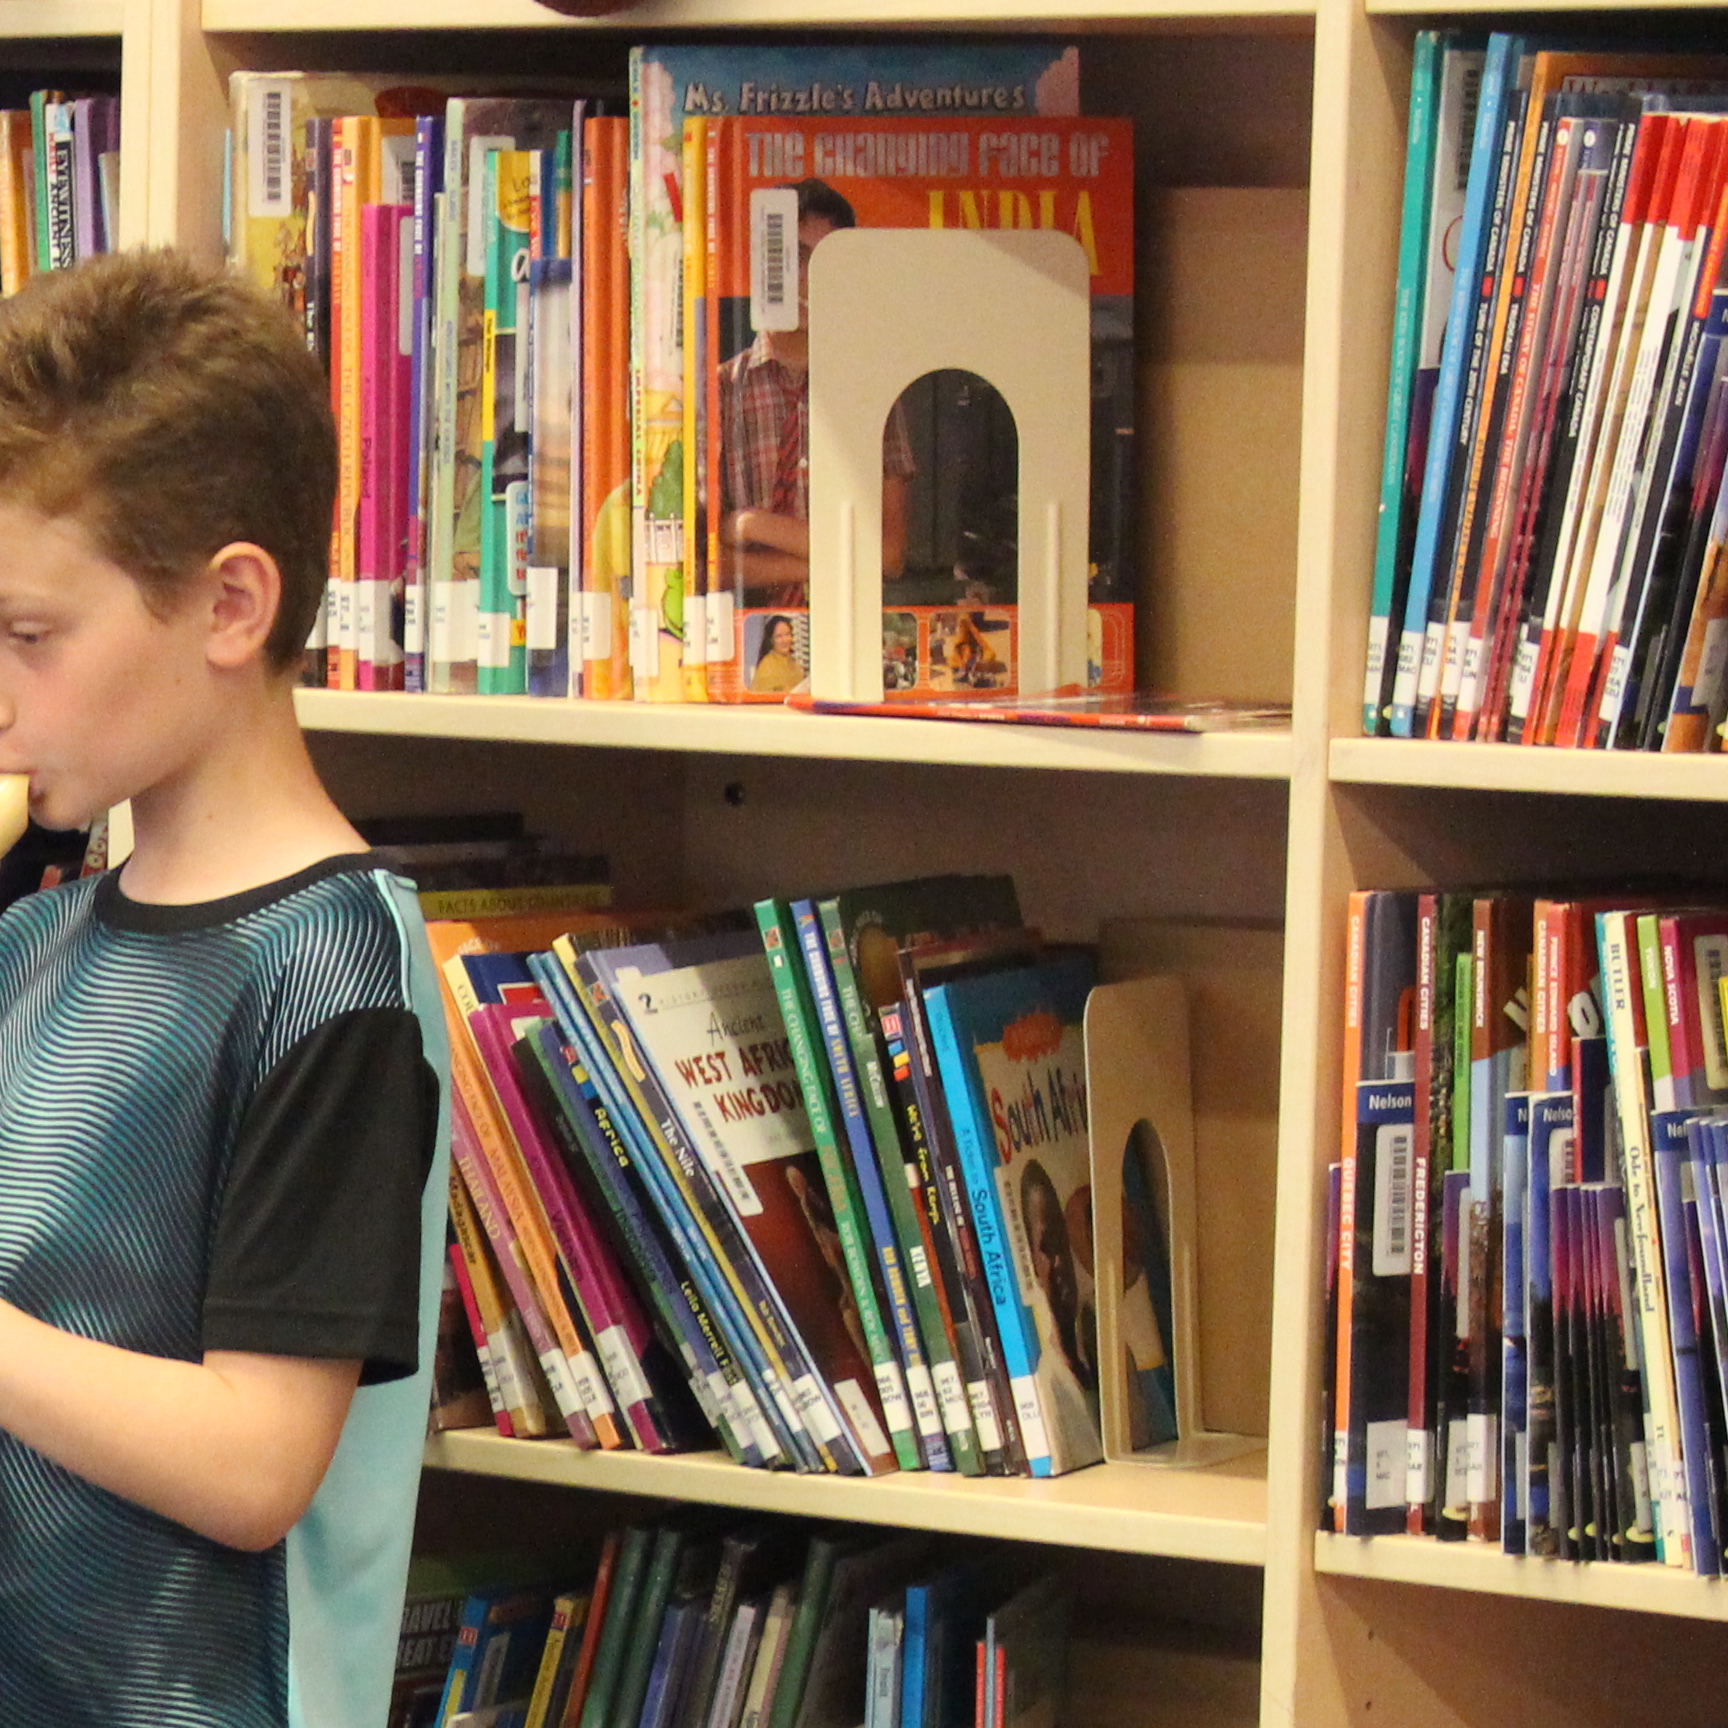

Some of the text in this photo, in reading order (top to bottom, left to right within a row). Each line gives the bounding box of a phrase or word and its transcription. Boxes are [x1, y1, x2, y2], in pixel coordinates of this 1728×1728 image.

[683, 81, 1025, 114] Ms. Frizzle's Adventures
[55, 142, 75, 270] EYEWITNESS
[1485, 154, 1511, 273] MINISTERS CANADA
[1517, 153, 1544, 273] MINISTERS CANADA
[1611, 157, 1630, 218] MINISTERS
[1599, 230, 1616, 274] CANADA
[1568, 398, 1585, 438] CANADA
[361, 438, 373, 499] Poland
[1346, 915, 1360, 1028] CANADIAN CITIES
[1419, 916, 1432, 1031] CANADIAN CITIES
[1536, 920, 1547, 1034] CANADIAN CITIES
[1609, 943, 1625, 1011] BUTLER
[1664, 945, 1680, 1026] NOVA SCOTIA
[706, 1012, 766, 1047] Ancient
[785, 1012, 814, 1080] CHANGING
[1549, 1031, 1558, 1076] ISLAND
[675, 1051, 735, 1088] WEST
[1369, 1094, 1412, 1110] Nelson
[660, 1118, 696, 1178] The Nile
[991, 1071, 1044, 1165] South
[907, 1104, 941, 1226] We're from Kenya
[971, 1189, 1006, 1305] South Africa
[1338, 1157, 1354, 1270] QUEBEC CITY
[1413, 1157, 1427, 1275] FREDERICTON
[1629, 1145, 1655, 1313] Ode Newfoundland
[909, 1245, 931, 1288] KENYA
